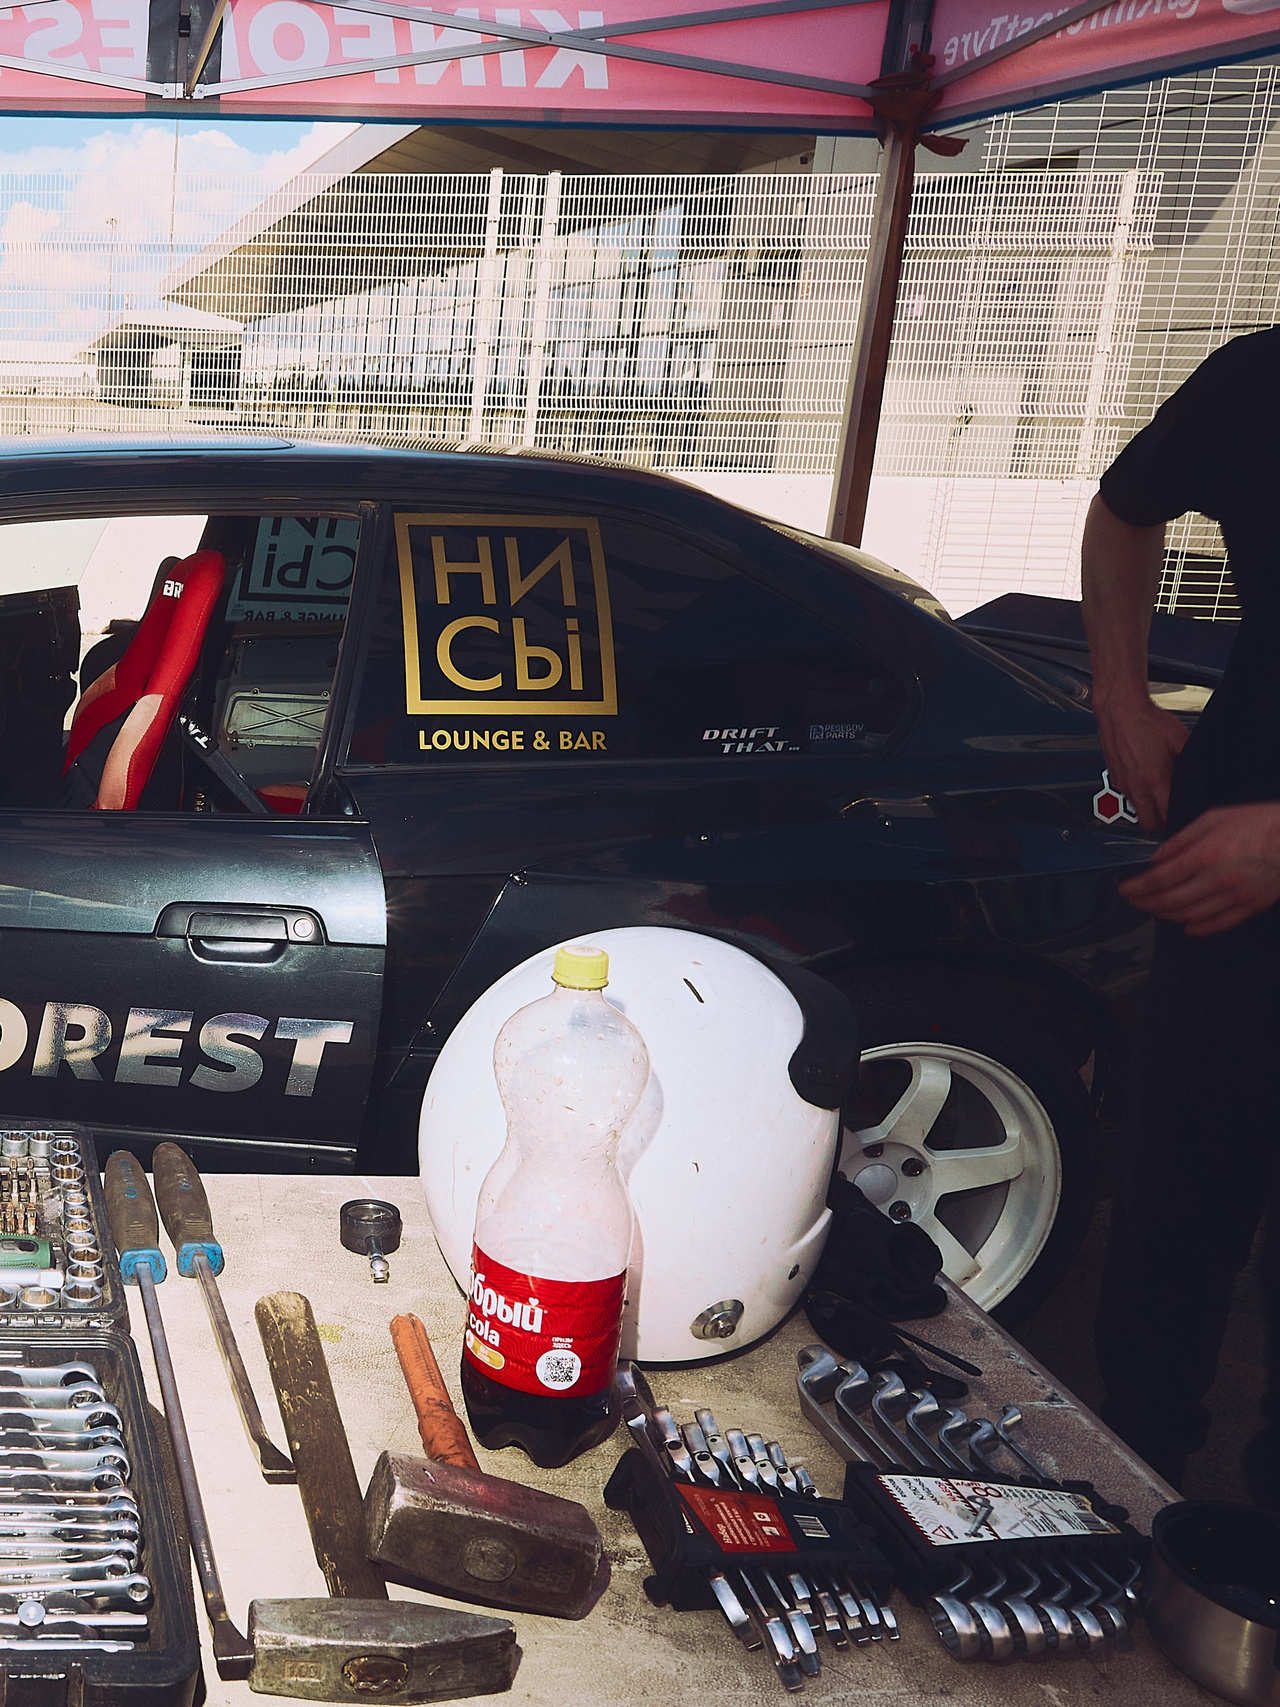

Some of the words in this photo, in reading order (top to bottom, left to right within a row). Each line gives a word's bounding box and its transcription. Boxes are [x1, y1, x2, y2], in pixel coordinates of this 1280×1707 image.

[419, 730, 524, 750] LOUNGE
[533, 731, 550, 750] &
[559, 731, 607, 750] BAR
[703, 727, 779, 740] DRIFT
[470, 1313, 500, 1347] cola
